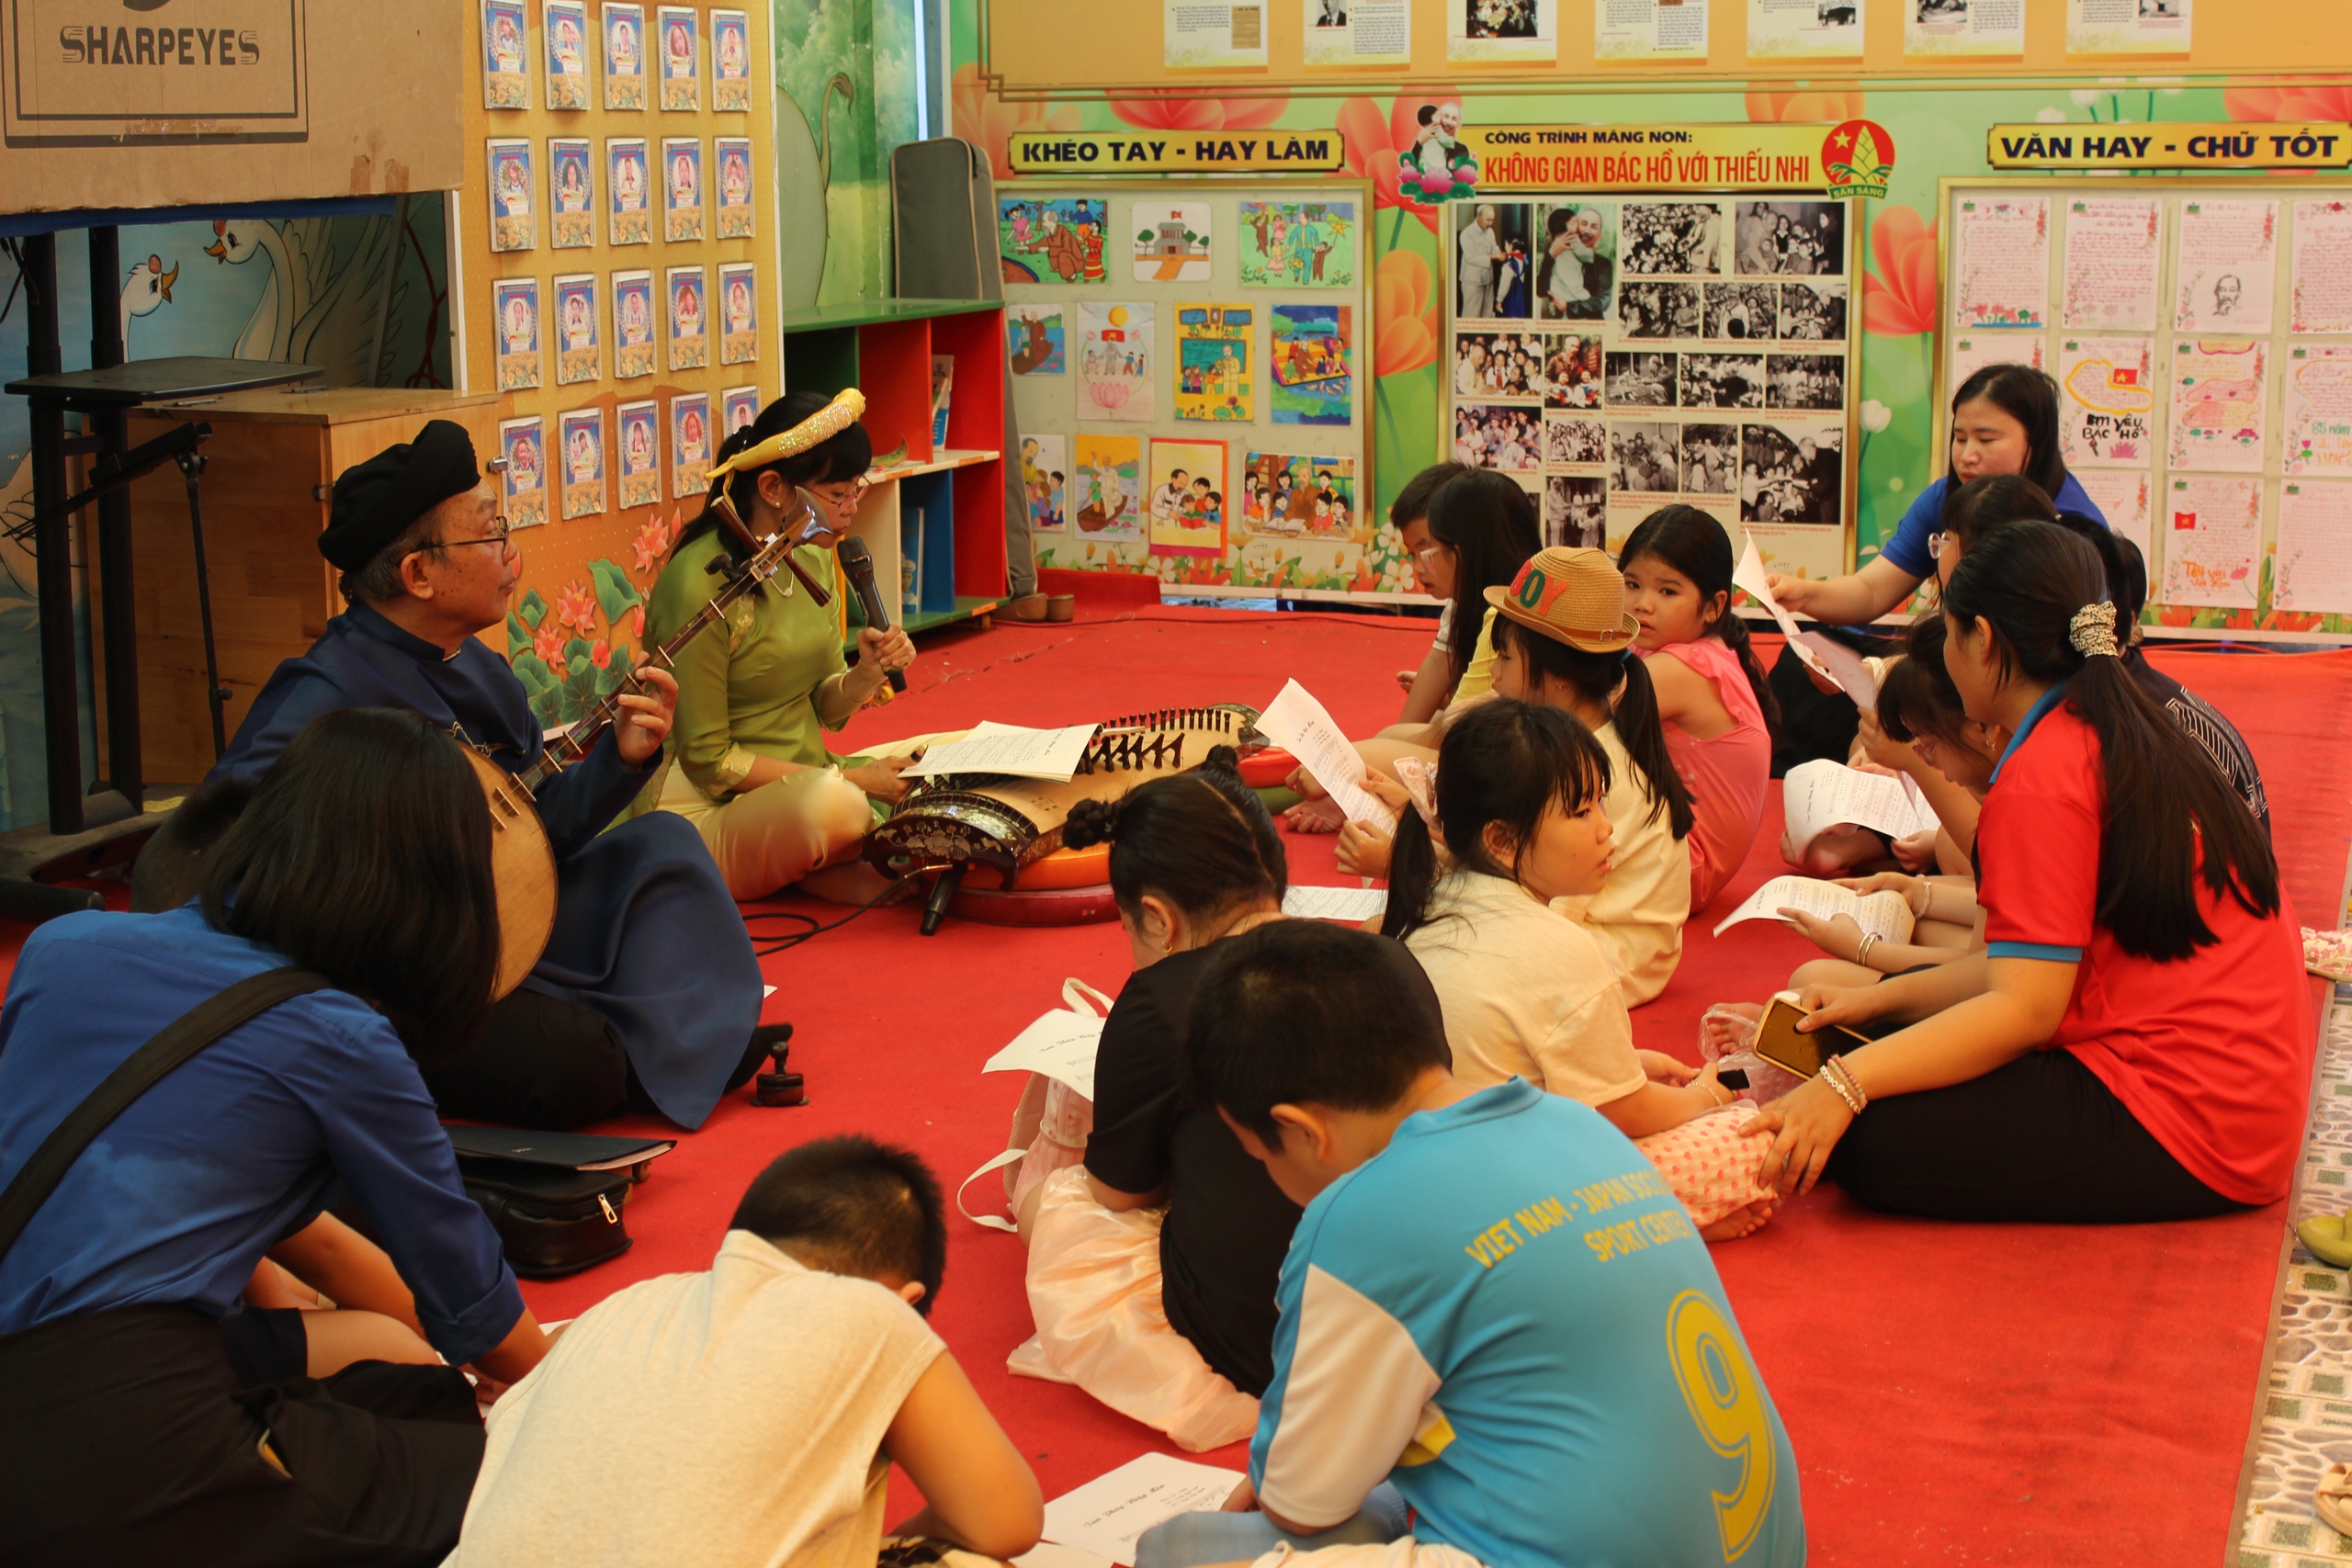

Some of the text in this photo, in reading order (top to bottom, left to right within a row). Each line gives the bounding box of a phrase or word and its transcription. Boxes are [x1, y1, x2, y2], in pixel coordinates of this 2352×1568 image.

[60, 26, 260, 65] SHARPEYES
[1023, 139, 1099, 163] KHÉO
[1108, 141, 1167, 162] TAY
[1195, 141, 1257, 161] HAY
[1266, 137, 1329, 161] LÀM
[1485, 130, 1532, 144] CÔNG
[1536, 130, 1588, 143] TRÌNH
[1649, 131, 1693, 143] NON:
[2000, 132, 2073, 159] VĂN
[2083, 136, 2152, 158] HAY
[2188, 130, 2258, 158] CHỮ
[2269, 128, 2339, 158] TỐT
[1485, 148, 1810, 184] KHÔNG GIAN BÁC HỒ VỚI THIẾU NHI
[1509, 558, 1569, 617] BOY
[1464, 1217, 1524, 1269] VIET
[1513, 1195, 1574, 1238] NAM
[1572, 1178, 1636, 1214] JAPAN
[1583, 1219, 1650, 1262] SPORT
[1666, 1289, 1777, 1565] 9
